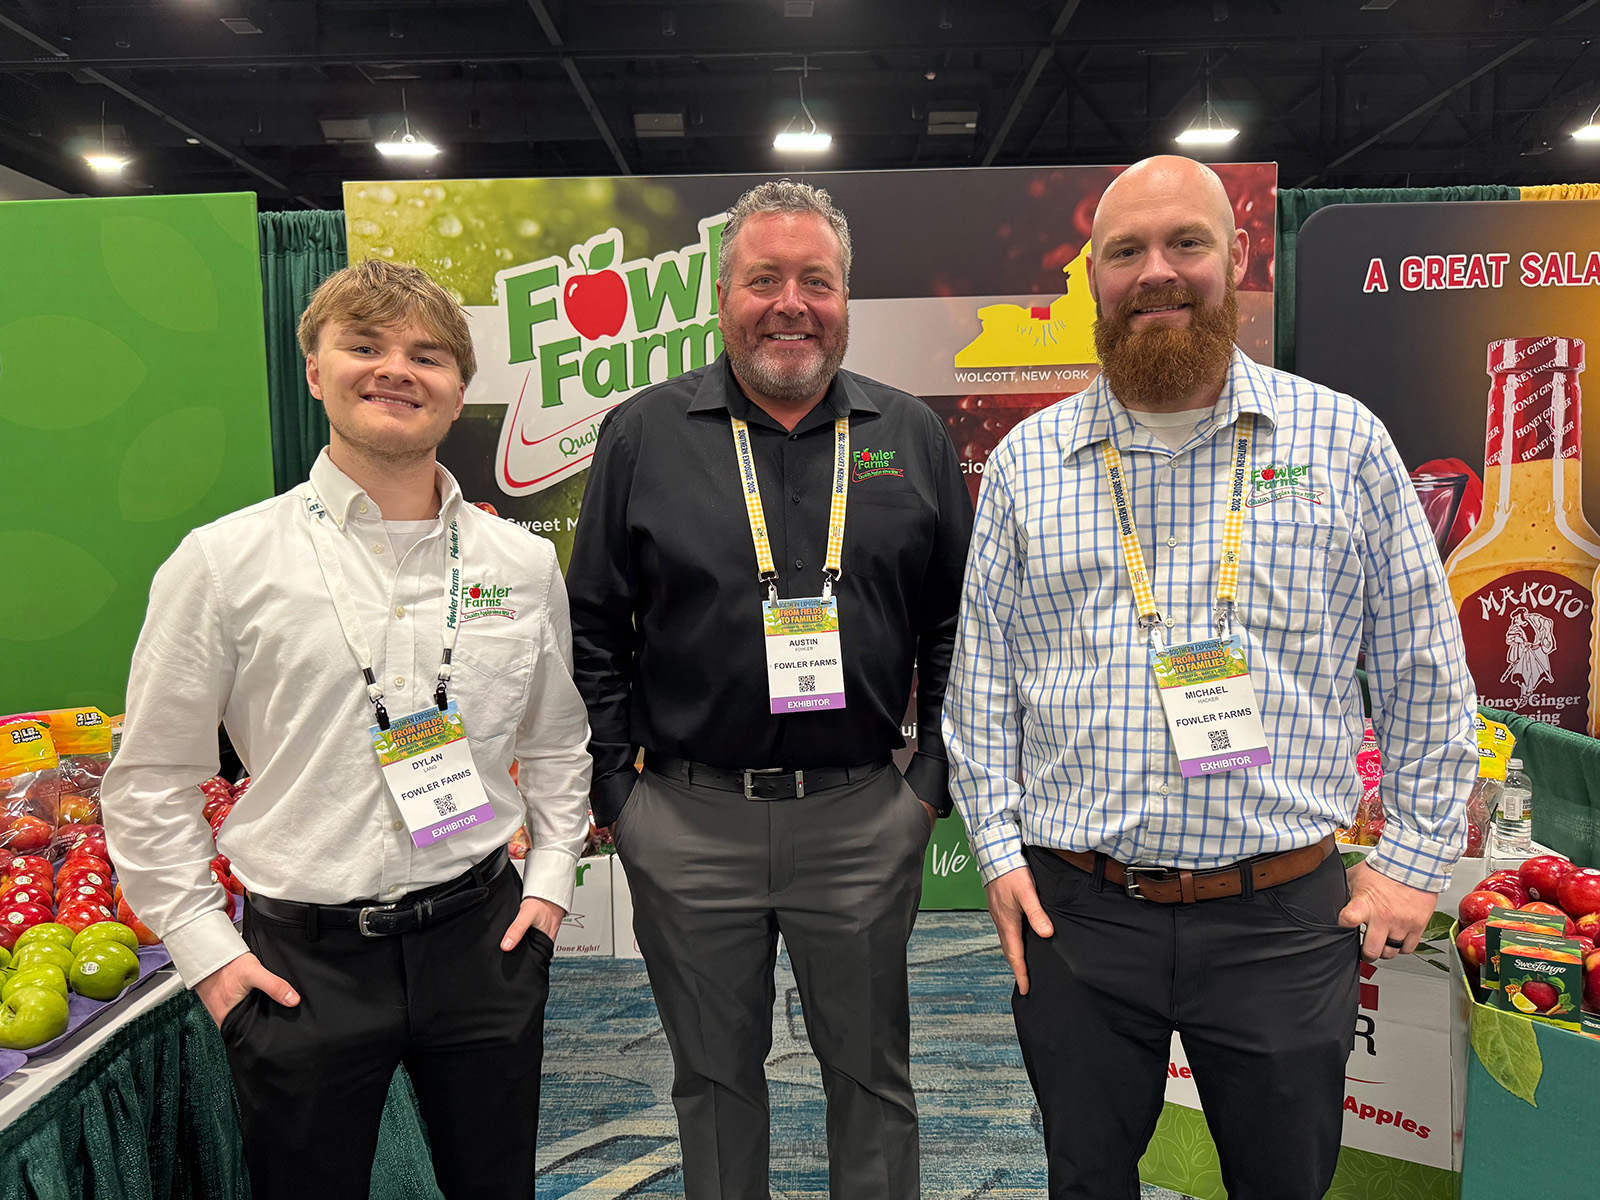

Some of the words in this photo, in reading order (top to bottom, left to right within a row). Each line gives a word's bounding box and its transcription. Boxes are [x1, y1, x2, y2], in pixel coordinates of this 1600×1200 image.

[1363, 258, 1389, 293] A
[1400, 253, 1509, 291] GREAT
[954, 371, 1018, 383] WOLCOTT,
[1021, 370, 1051, 381] NEW
[1054, 369, 1089, 380] YORK
[1236, 438, 1248, 467] SOUTHERN
[858, 460, 890, 470] Farms
[1232, 468, 1245, 497] EXPOSURE
[1256, 478, 1299, 491] Farms
[1113, 480, 1126, 508] EXPOSURE
[1118, 507, 1132, 536] SOUTHERN
[449, 568, 459, 597] Farms
[465, 598, 502, 608] Farms
[1477, 581, 1583, 621] MAKOTO
[780, 608, 800, 617] FROM
[800, 607, 823, 615] FIELDS
[781, 616, 791, 625] TO
[791, 614, 823, 624] FAMILIES
[789, 638, 818, 647] AUSTIN
[774, 660, 808, 670] FOWLER
[810, 658, 838, 667] FARMS
[1171, 654, 1196, 666] FROM
[1197, 649, 1224, 660] FIELDS
[1174, 665, 1186, 674] TO
[1186, 657, 1226, 672] FAMILIES
[1184, 686, 1229, 700] MICHAEL
[1528, 691, 1581, 709] Ginger
[787, 698, 831, 709] EXHIBITOR
[76, 713, 84, 721] 2
[85, 712, 102, 721] LB.
[1175, 713, 1217, 727] FOWLER
[1219, 707, 1252, 721] FARMS
[12, 730, 21, 740] 2
[22, 727, 40, 737] LB.
[392, 725, 417, 740] FROM
[416, 717, 443, 732] FIELDS
[394, 737, 407, 748] TO
[407, 724, 445, 743] FAMILIES
[411, 753, 443, 770] DYLAN
[423, 765, 438, 773] LANG
[1200, 755, 1252, 772] EXHIBITOR
[401, 781, 440, 801] FOWLER
[441, 769, 472, 786] FARMS
[431, 814, 478, 838] EXHIBITOR
[932, 841, 970, 877] We
[555, 944, 576, 952] Done
[576, 944, 601, 953] Right!
[1343, 1095, 1432, 1139] Apples
